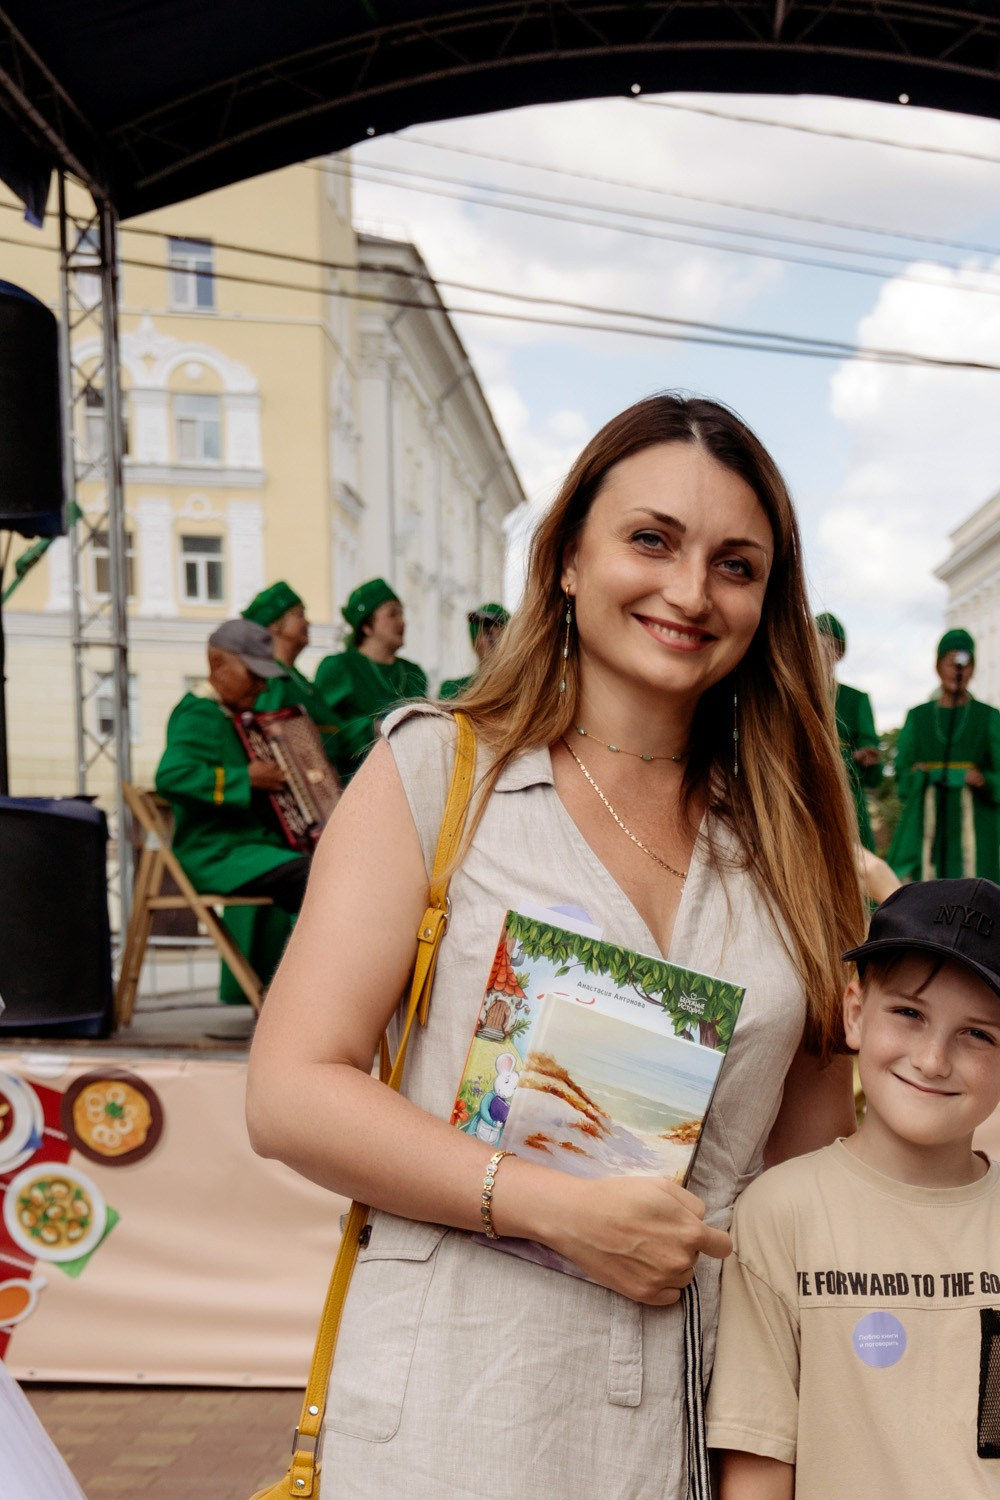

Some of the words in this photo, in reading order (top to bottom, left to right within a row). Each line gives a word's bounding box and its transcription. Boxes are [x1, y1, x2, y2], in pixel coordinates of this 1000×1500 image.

[933, 904, 993, 936] NYC
[814, 1270, 909, 1296] FORWARD
[911, 1274, 935, 1297] TO
[940, 1272, 974, 1298] THE
